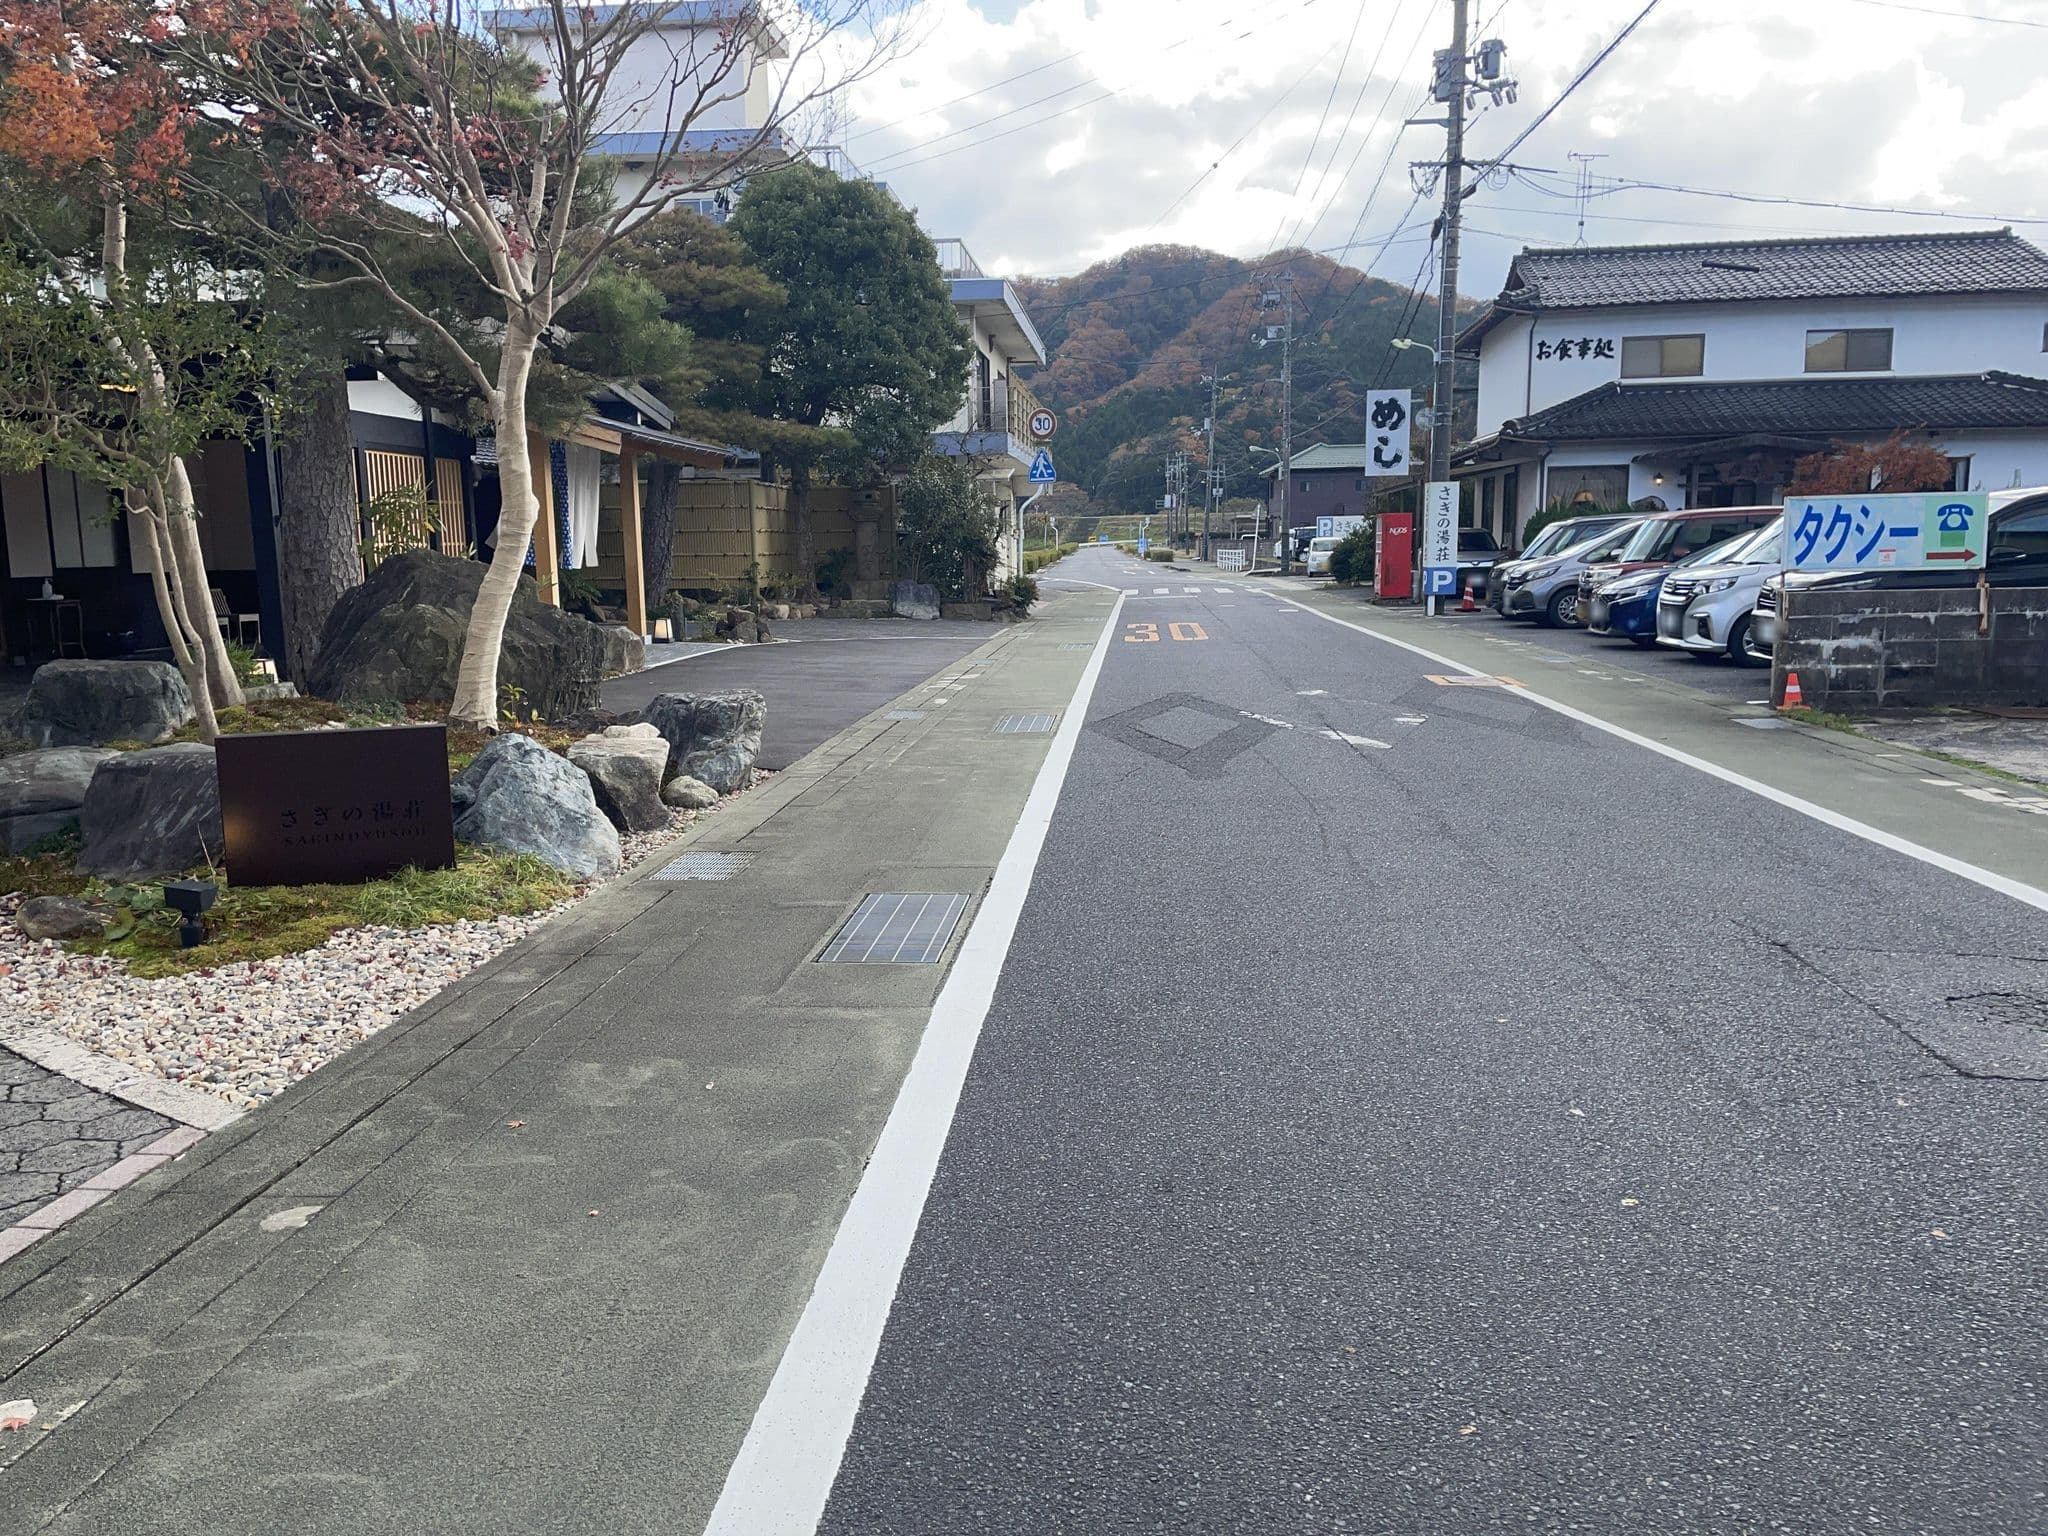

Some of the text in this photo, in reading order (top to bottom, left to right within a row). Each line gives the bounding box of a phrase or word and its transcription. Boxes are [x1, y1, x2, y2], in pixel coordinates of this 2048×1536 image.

[1536, 337, 1614, 361] お食事処
[1034, 417, 1051, 431] 30
[1371, 397, 1406, 469] めし
[1319, 519, 1332, 537] P
[1436, 486, 1451, 562] さぎの湯荘
[1793, 504, 1919, 566] タクシー
[1432, 570, 1453, 593] P
[1124, 622, 1209, 642] 30
